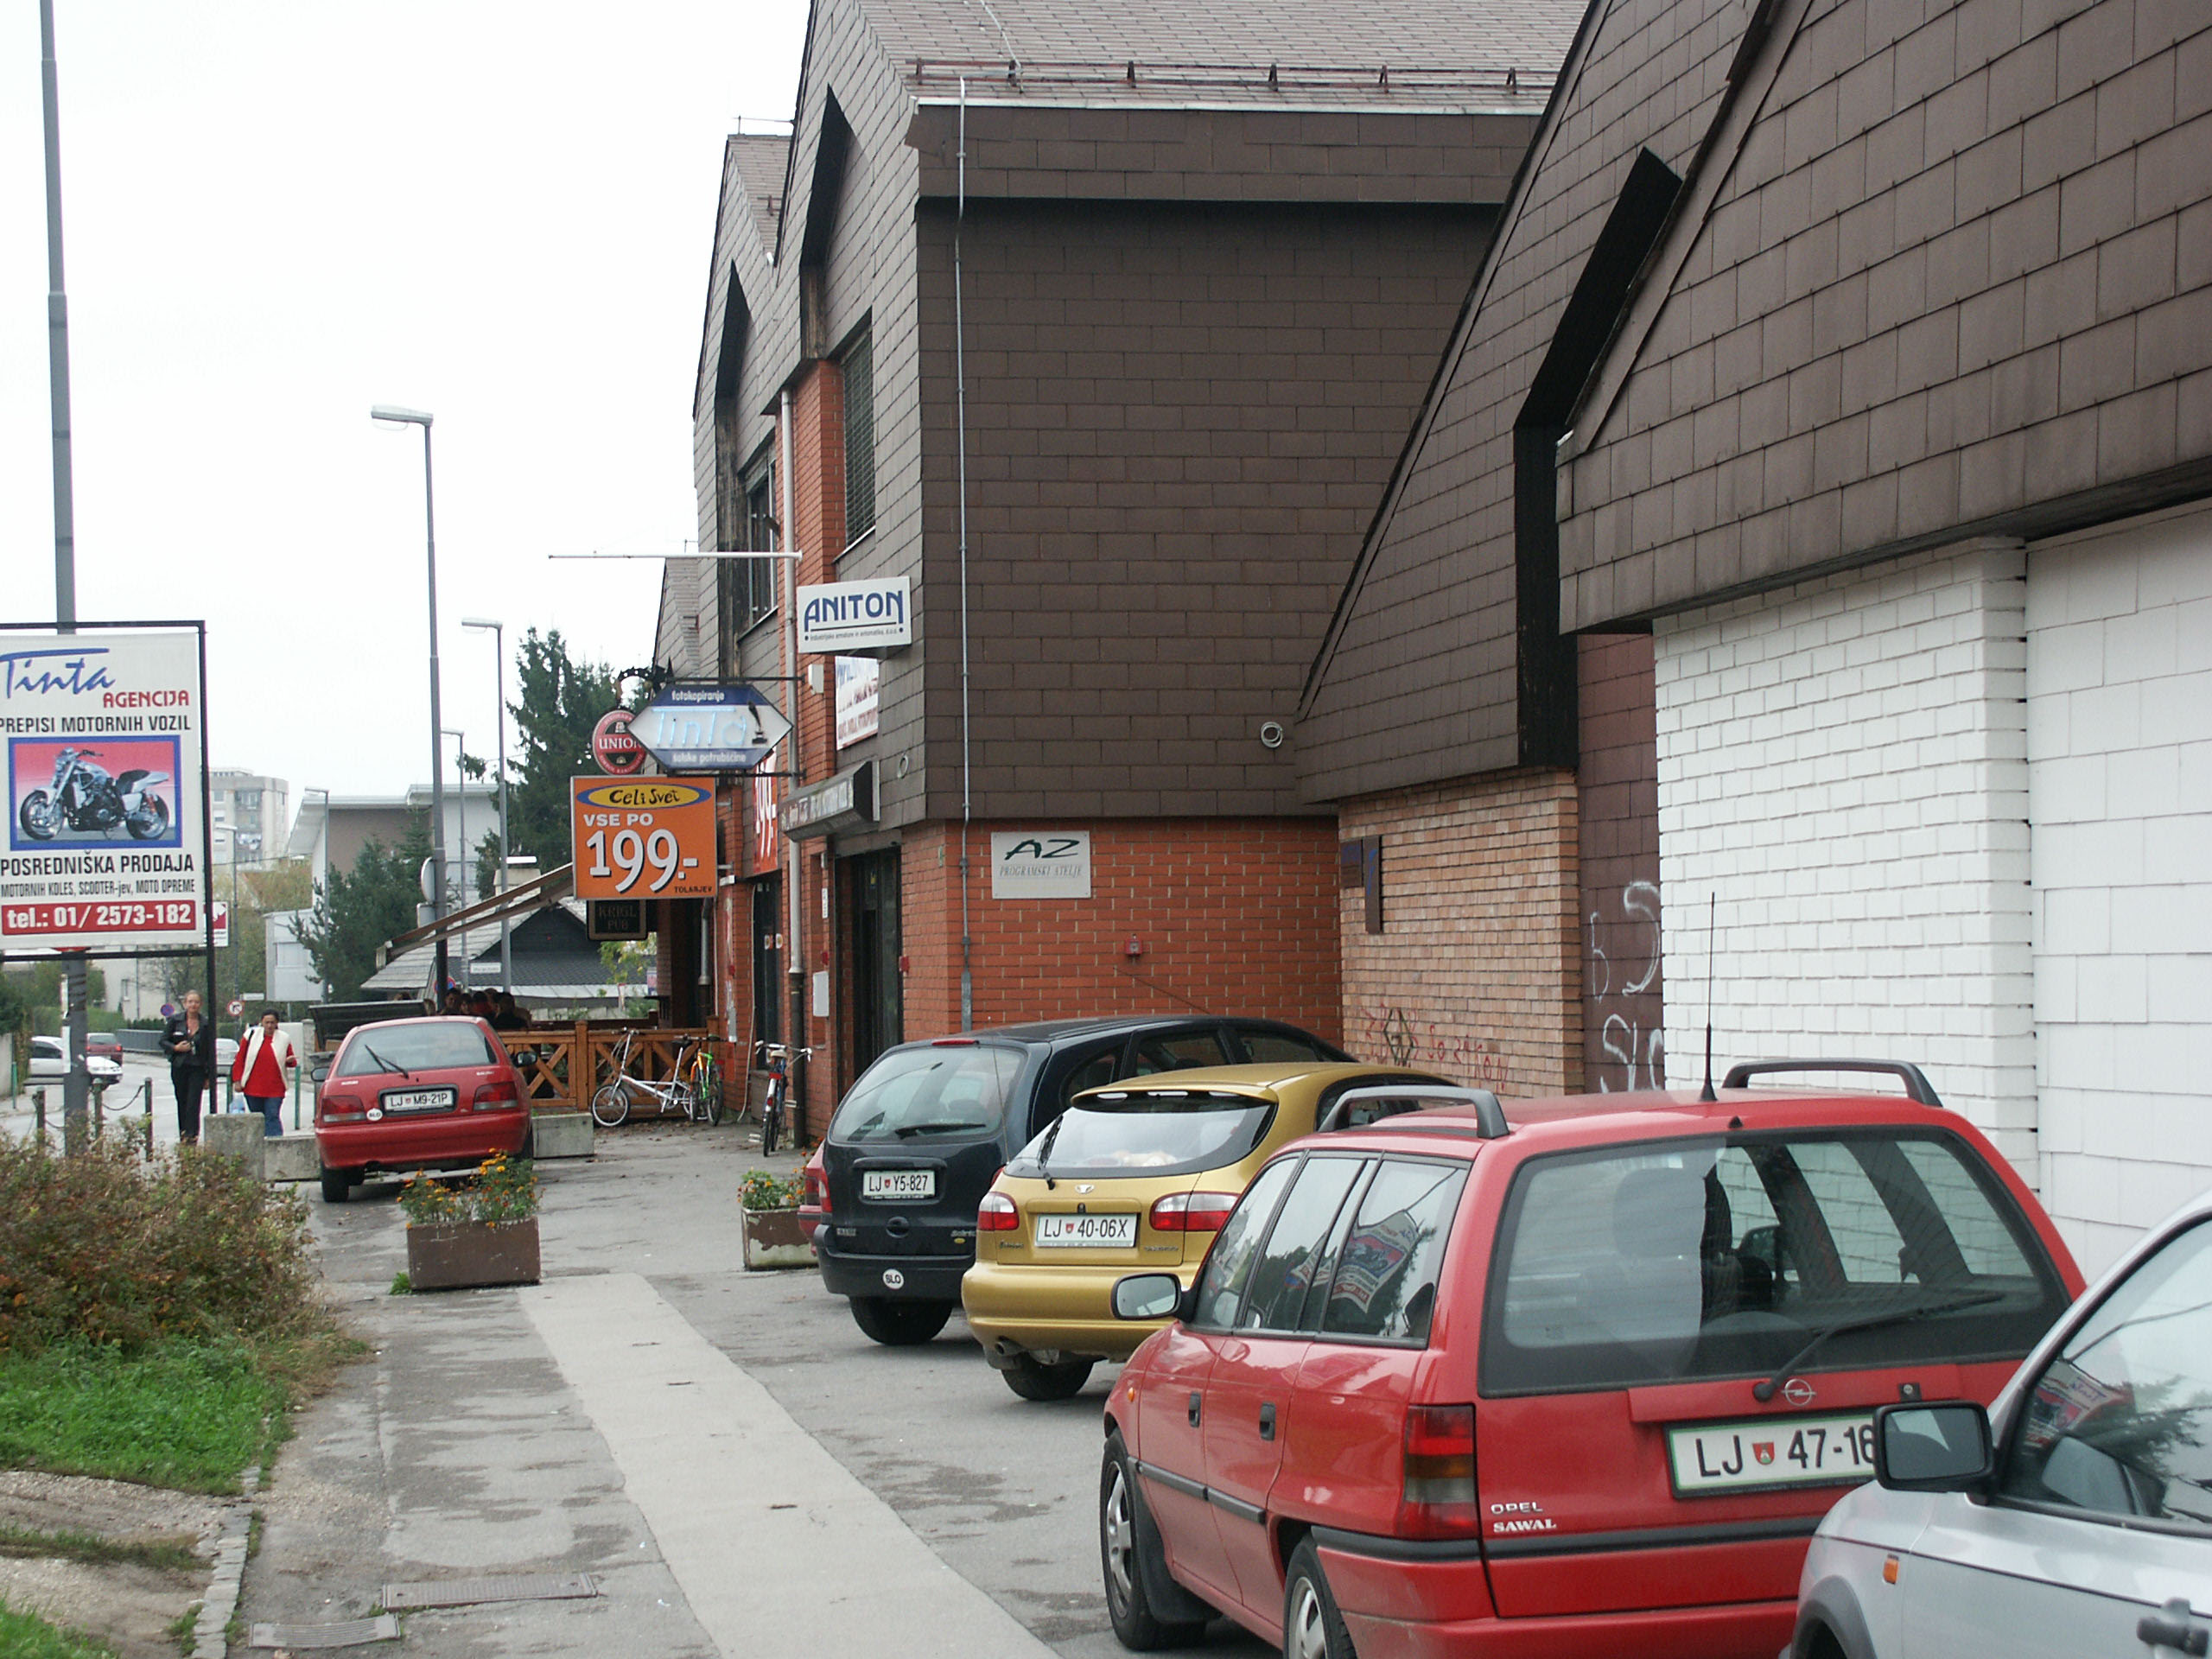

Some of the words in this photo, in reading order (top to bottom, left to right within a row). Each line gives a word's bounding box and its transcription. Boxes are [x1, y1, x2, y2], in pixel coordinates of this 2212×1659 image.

[804, 590, 904, 632] ANITON
[0, 647, 116, 699] Tinta
[103, 690, 189, 709] AGENCIJA
[0, 717, 54, 734] PREPISI
[61, 716, 143, 733] MOTORNIH
[149, 715, 191, 731] VOZIL
[609, 789, 645, 804] Celi
[648, 788, 681, 805] Svet
[583, 814, 620, 827] VSE
[626, 813, 653, 826] PO
[1004, 839, 1080, 861] AZ
[1, 849, 116, 876] POSREDNIŠKA
[120, 854, 194, 873] PRODAJA
[1, 882, 46, 898] MOTORNIH
[48, 881, 76, 897] KOLES,
[136, 880, 159, 893] MOTO
[162, 879, 195, 893] OPREME
[7, 908, 48, 929] tel.:
[97, 904, 191, 926] 2573-182
[391, 1096, 404, 1107] LJ
[414, 1093, 448, 1105] M9-21P
[869, 1176, 881, 1192] LJ
[893, 1175, 928, 1192] Y5-827
[1044, 1219, 1062, 1237] LJ
[1077, 1218, 1128, 1237] 40-06X
[885, 1274, 901, 1284] SLO
[1695, 1434, 1744, 1478] LJ
[1788, 1424, 1874, 1469] 47-16
[1491, 1501, 1543, 1515] OPEL
[1493, 1518, 1557, 1533] SAWAL
